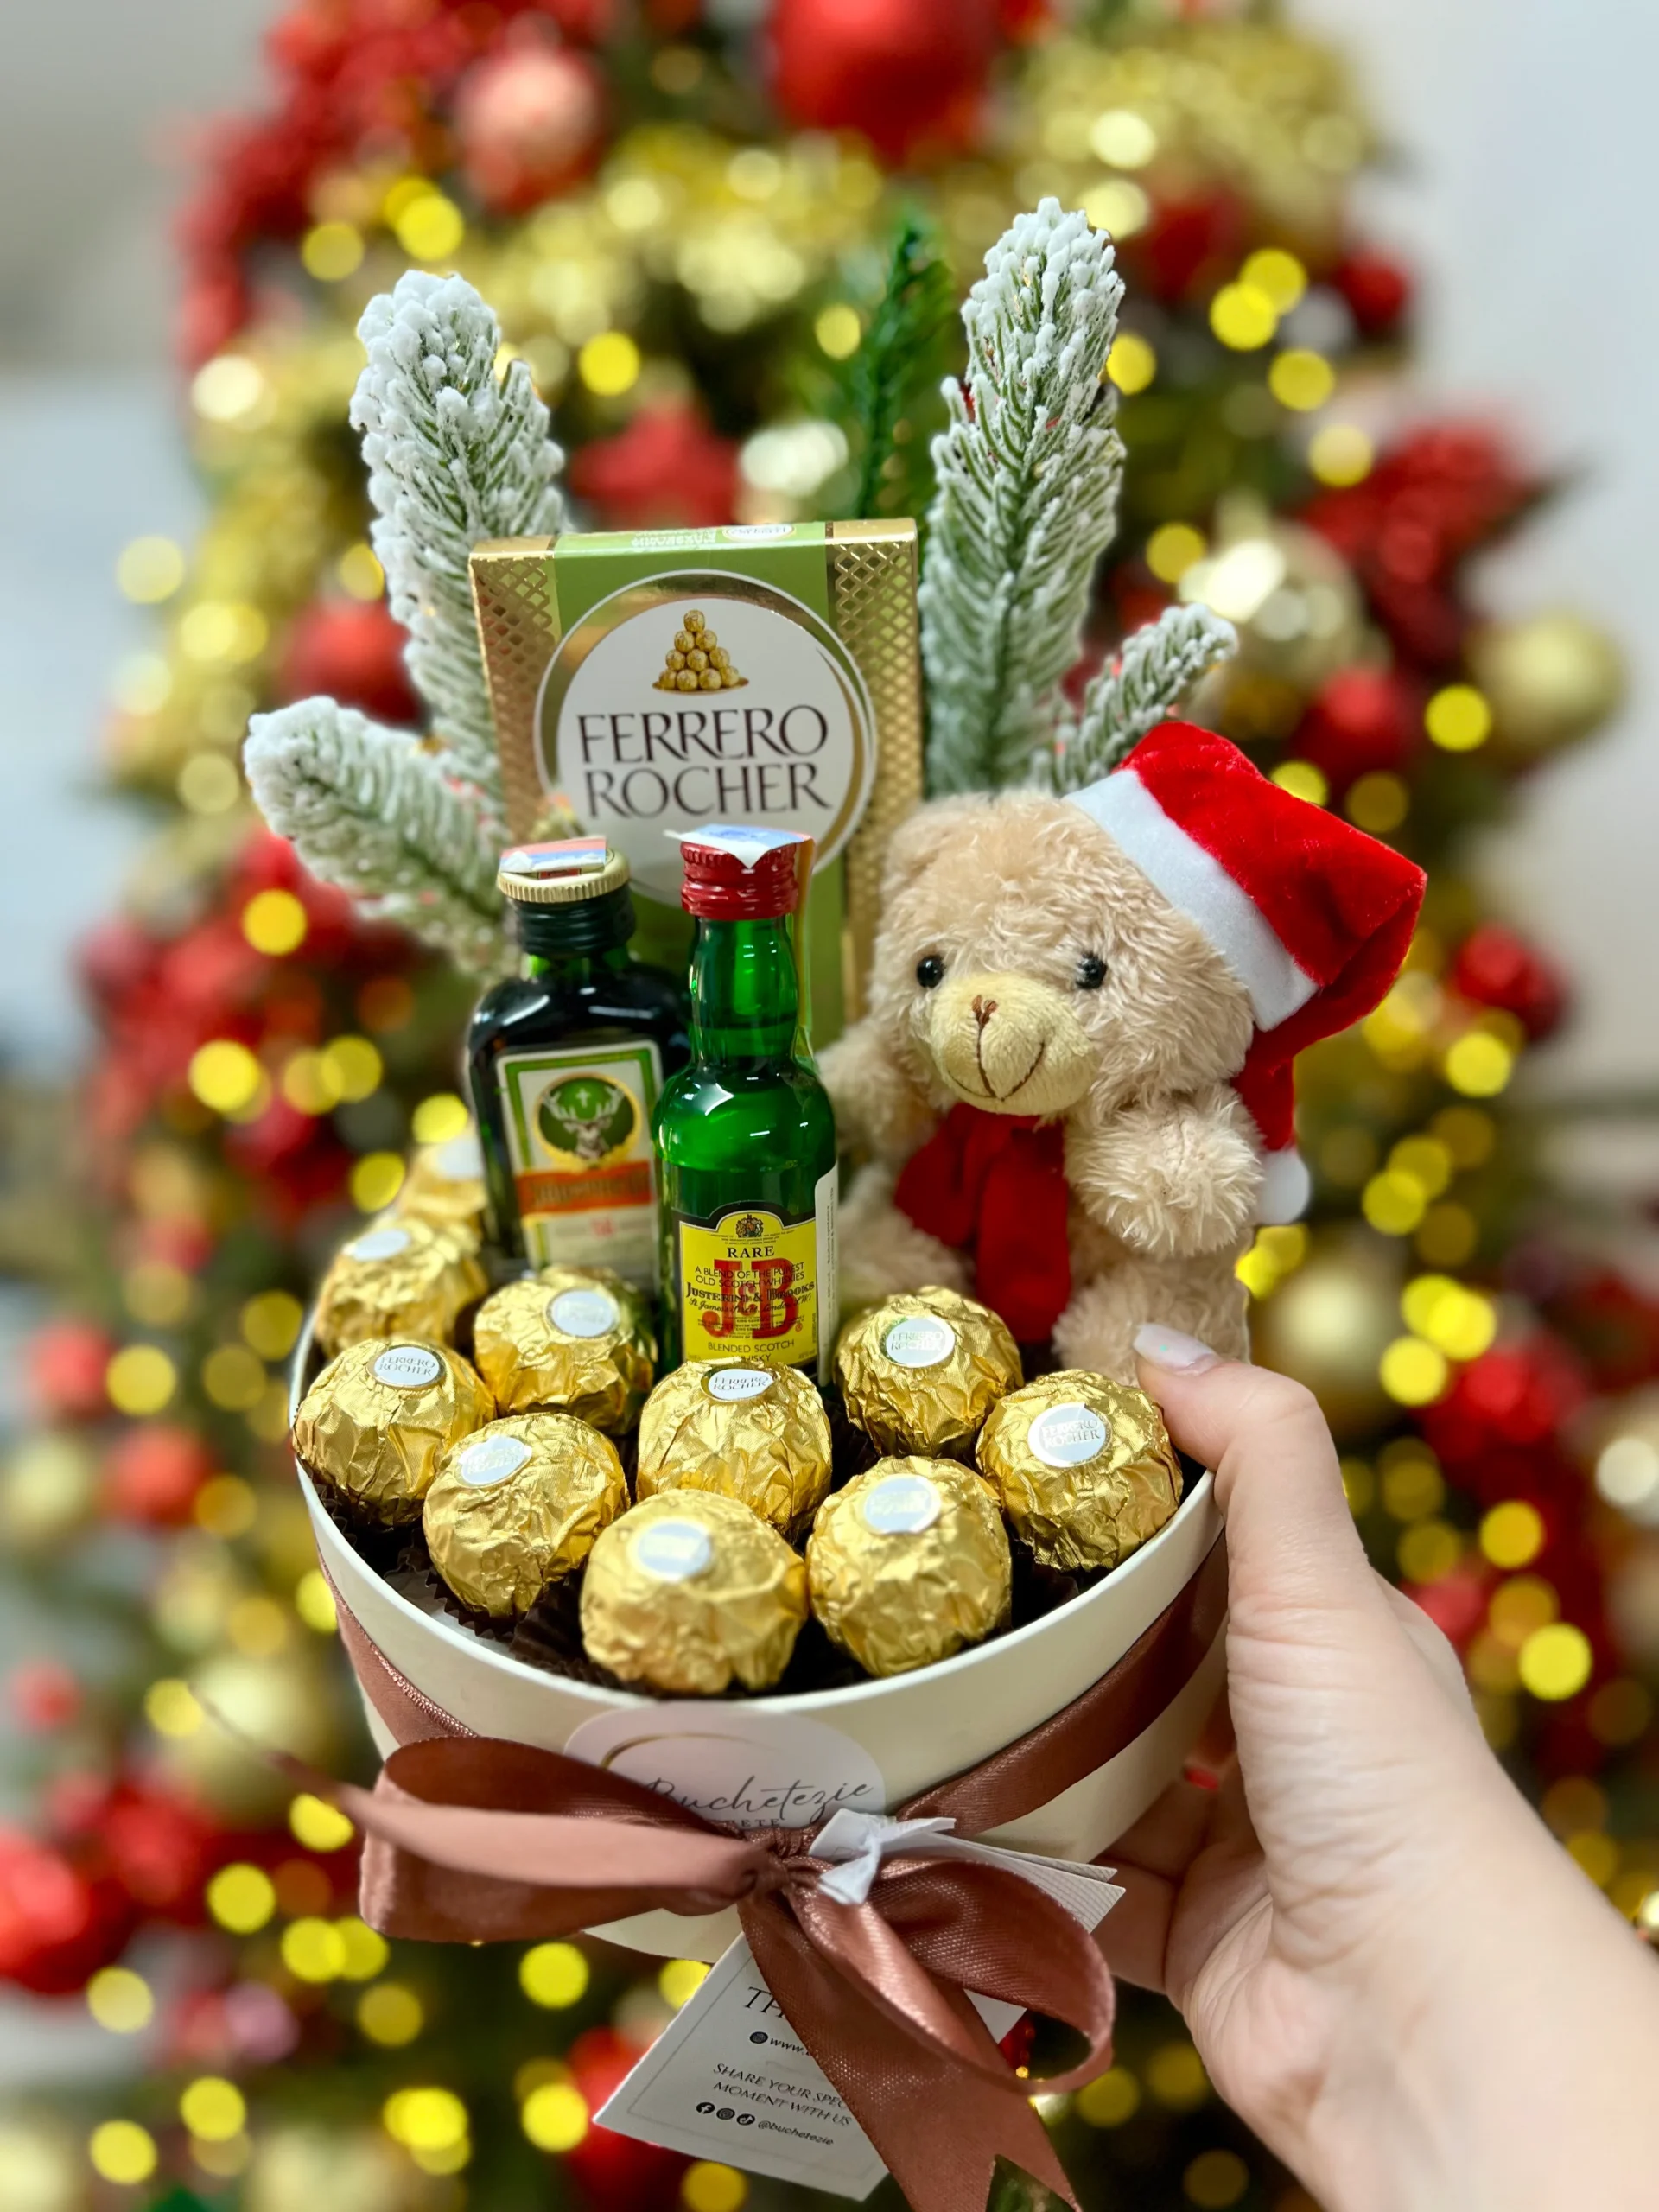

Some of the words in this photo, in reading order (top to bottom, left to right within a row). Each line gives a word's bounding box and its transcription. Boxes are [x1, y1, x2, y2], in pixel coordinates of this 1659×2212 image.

[577, 704, 829, 765] FERRERO
[584, 763, 835, 820] ROCHER
[727, 1245, 774, 1258] RARE
[695, 1266, 702, 1274] A
[704, 1267, 734, 1279] BLEND
[737, 1270, 750, 1279] OF
[753, 1268, 771, 1278] THE
[773, 1262, 805, 1276] PUREST
[696, 1275, 716, 1287] OLD
[719, 1279, 760, 1288] SCOTCH
[753, 1292, 763, 1303] &
[708, 1341, 751, 1353] BLENDED
[754, 1339, 794, 1352] SCOTCH
[379, 1363, 432, 1376] ROCHER
[714, 2063, 766, 2087] SHARE
[769, 2079, 811, 2100] YOUR
[813, 2092, 847, 2110] SPEC
[714, 2082, 788, 2108] MOMENT
[790, 2101, 831, 2120] WITH
[832, 2115, 852, 2127] US
[758, 2120, 834, 2146] @buchetezie
